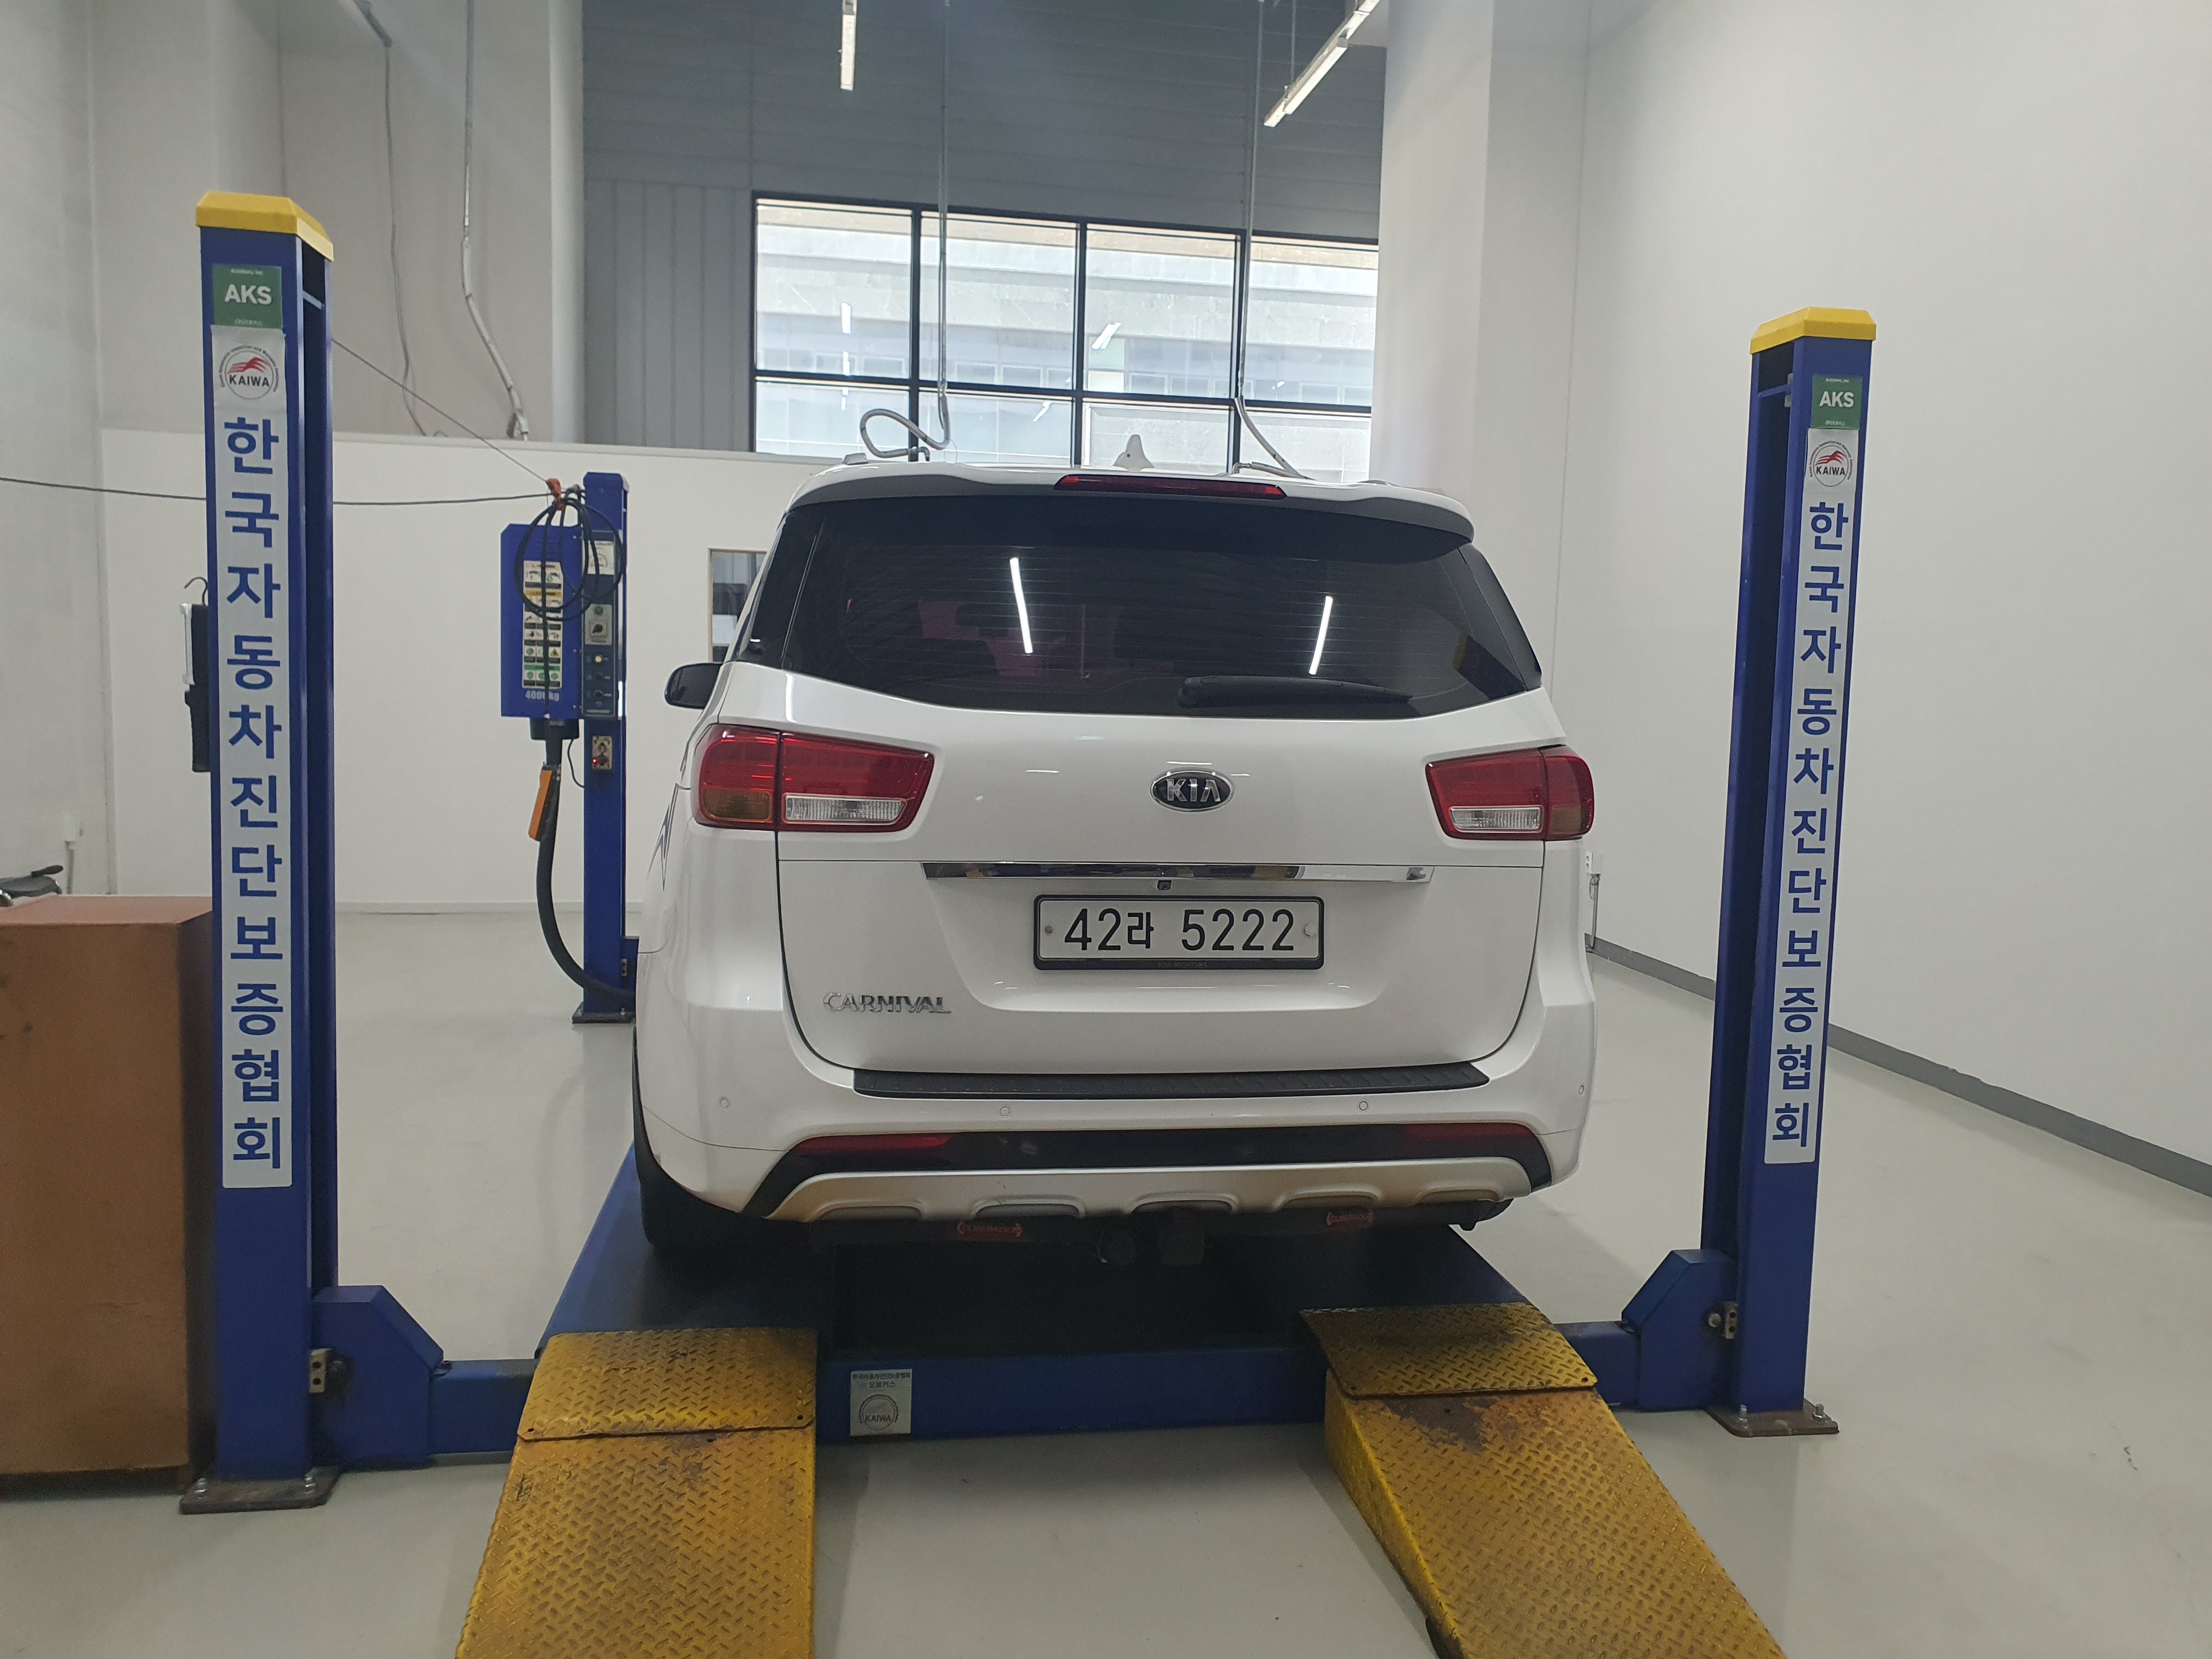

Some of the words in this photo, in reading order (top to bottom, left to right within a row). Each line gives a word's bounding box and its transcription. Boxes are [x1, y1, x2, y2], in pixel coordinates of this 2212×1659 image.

[224, 284, 272, 305] AKS
[229, 374, 270, 387] KAIWA
[1819, 391, 1854, 408] AKS
[1816, 466, 1846, 476] KAIWA
[224, 417, 284, 1169] 한국자동차진단보증협회
[1166, 778, 1221, 802] KIA
[1772, 501, 1849, 1148] 한국자동차진단보증협회
[1064, 908, 1154, 951] 42라
[1181, 909, 1294, 951] 5222
[823, 992, 952, 1014] CARNIVAL
